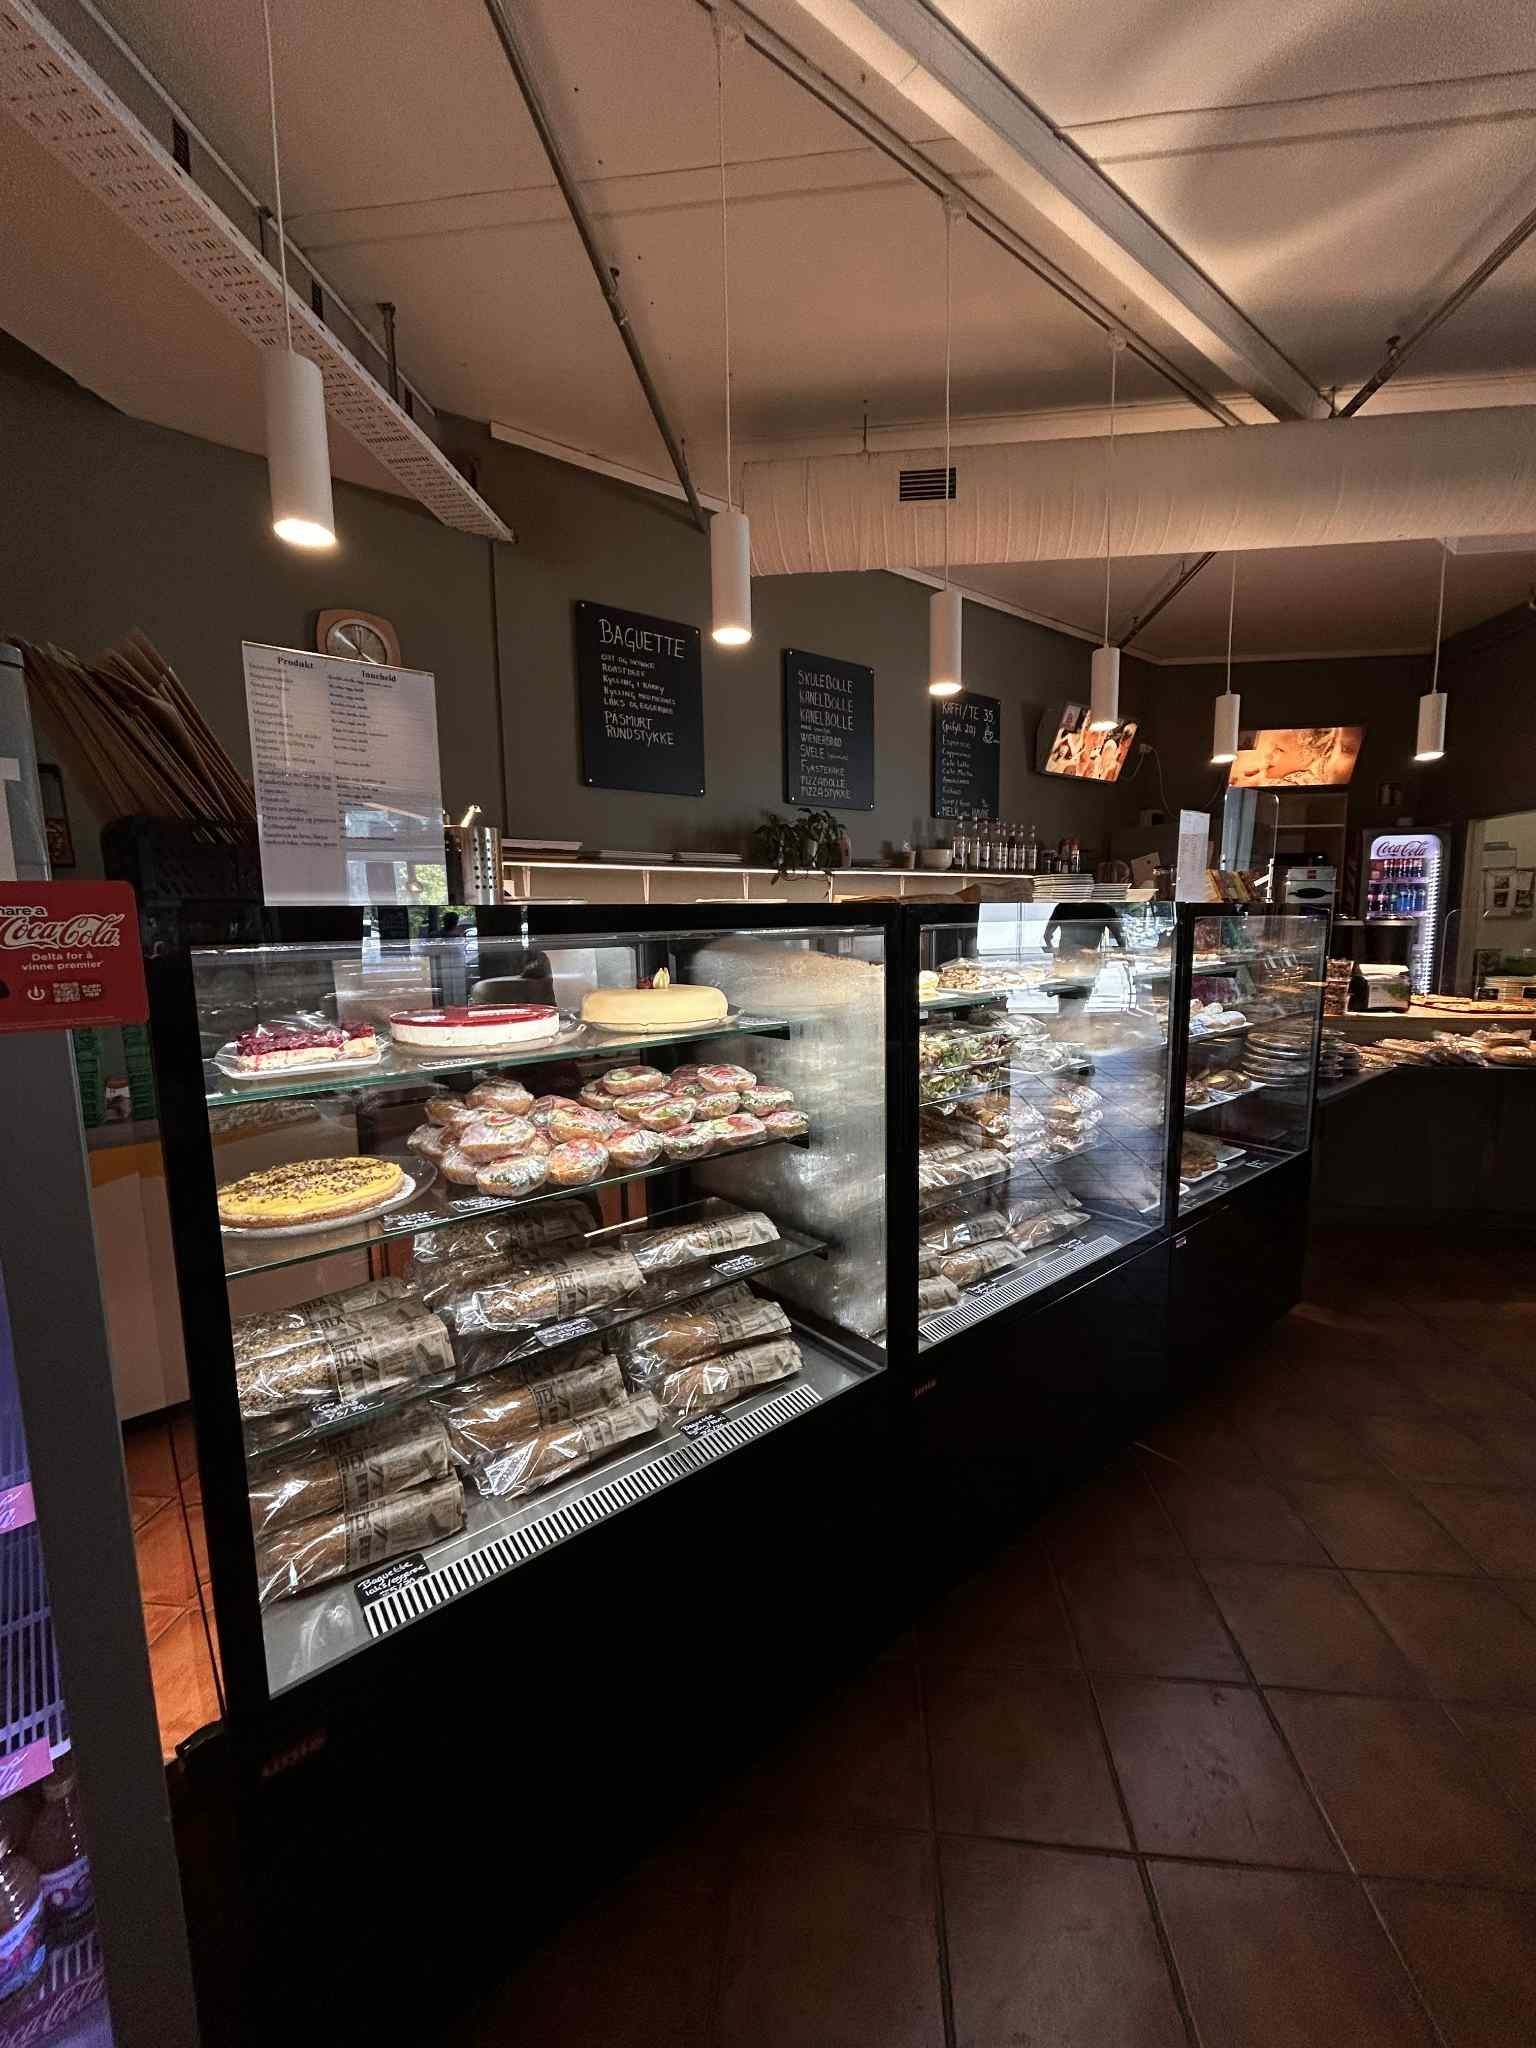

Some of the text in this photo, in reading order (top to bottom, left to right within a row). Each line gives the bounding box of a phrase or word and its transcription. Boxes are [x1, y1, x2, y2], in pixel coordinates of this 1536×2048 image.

[599, 618, 686, 658] BAGUETTE
[277, 656, 314, 670] Produkt
[800, 709, 854, 732] KANELBOLLE
[983, 708, 994, 723] 35
[605, 725, 675, 748] RUNDSTYKKE
[800, 743, 825, 760] SVELE
[1377, 840, 1430, 858] Coca-Cola
[34, 908, 45, 916] a
[0, 914, 125, 949] Coca-Cola
[66, 951, 82, 960] for
[22, 963, 54, 971] vinne
[357, 1561, 413, 1590] Baguette
